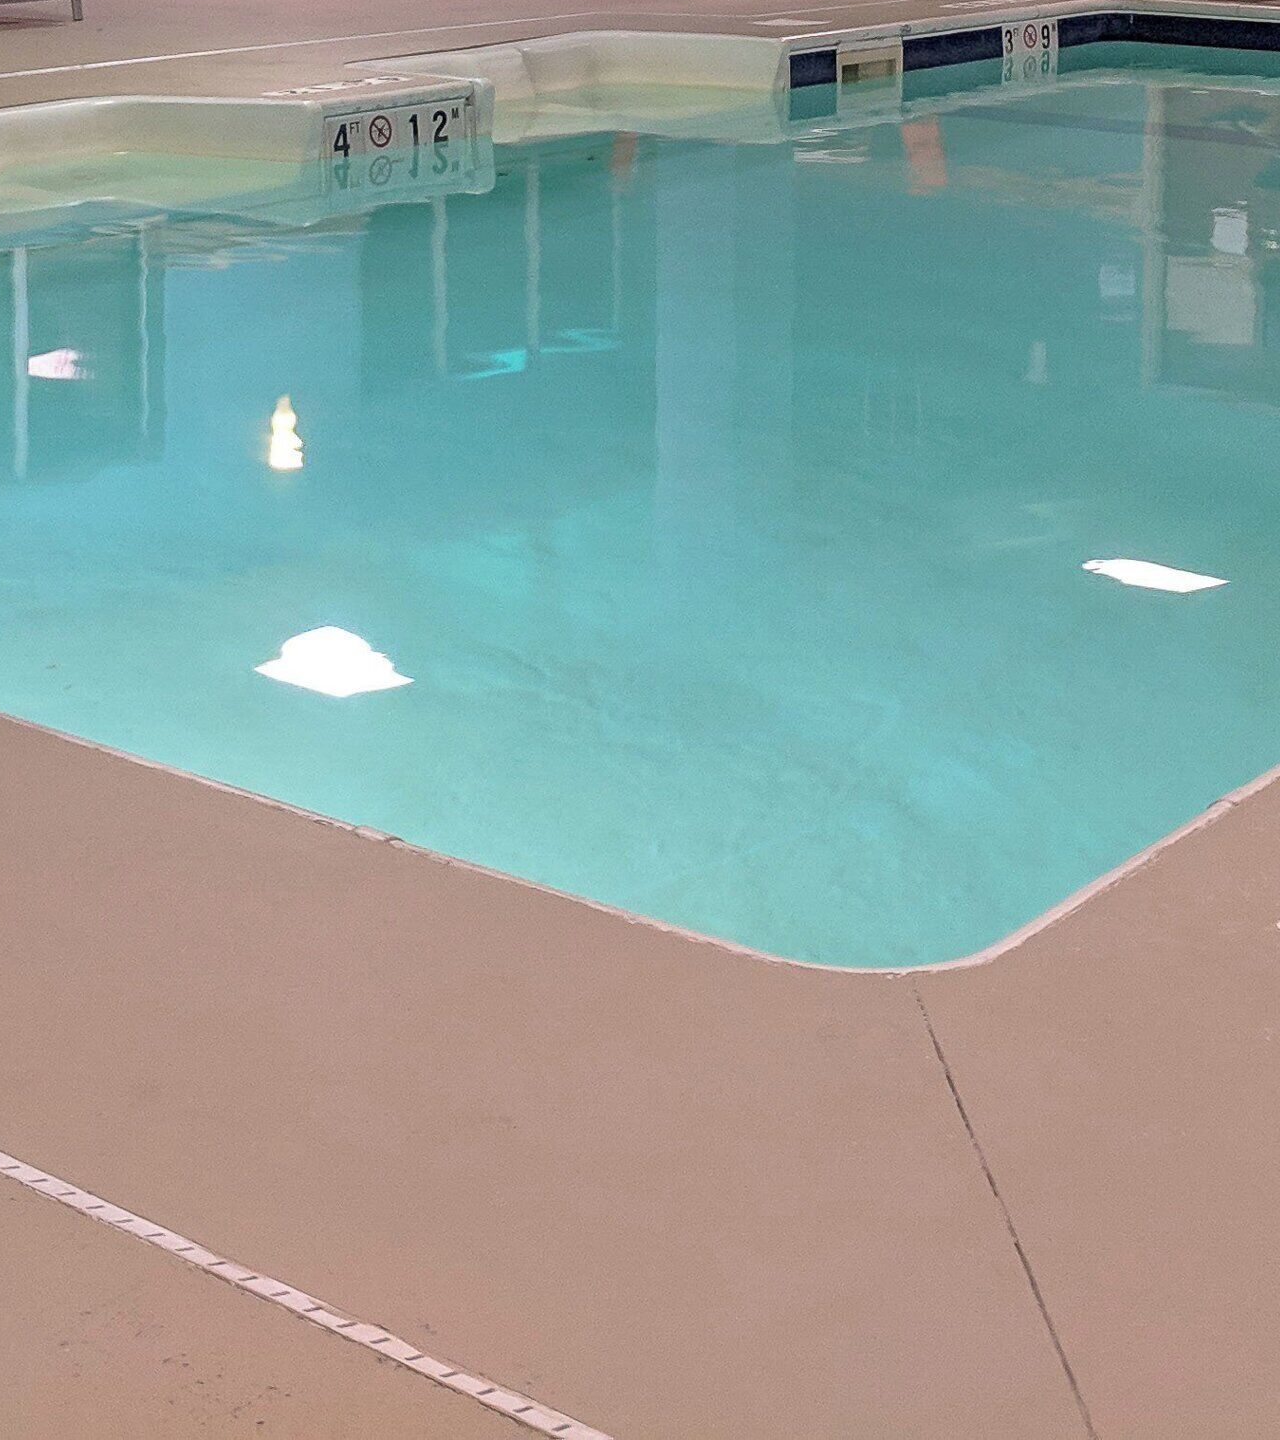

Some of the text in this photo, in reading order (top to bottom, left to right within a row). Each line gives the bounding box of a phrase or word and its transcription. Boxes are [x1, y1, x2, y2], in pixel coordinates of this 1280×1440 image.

[1004, 29, 1013, 53] 3
[1041, 24, 1050, 49] 9
[334, 123, 350, 157] 4
